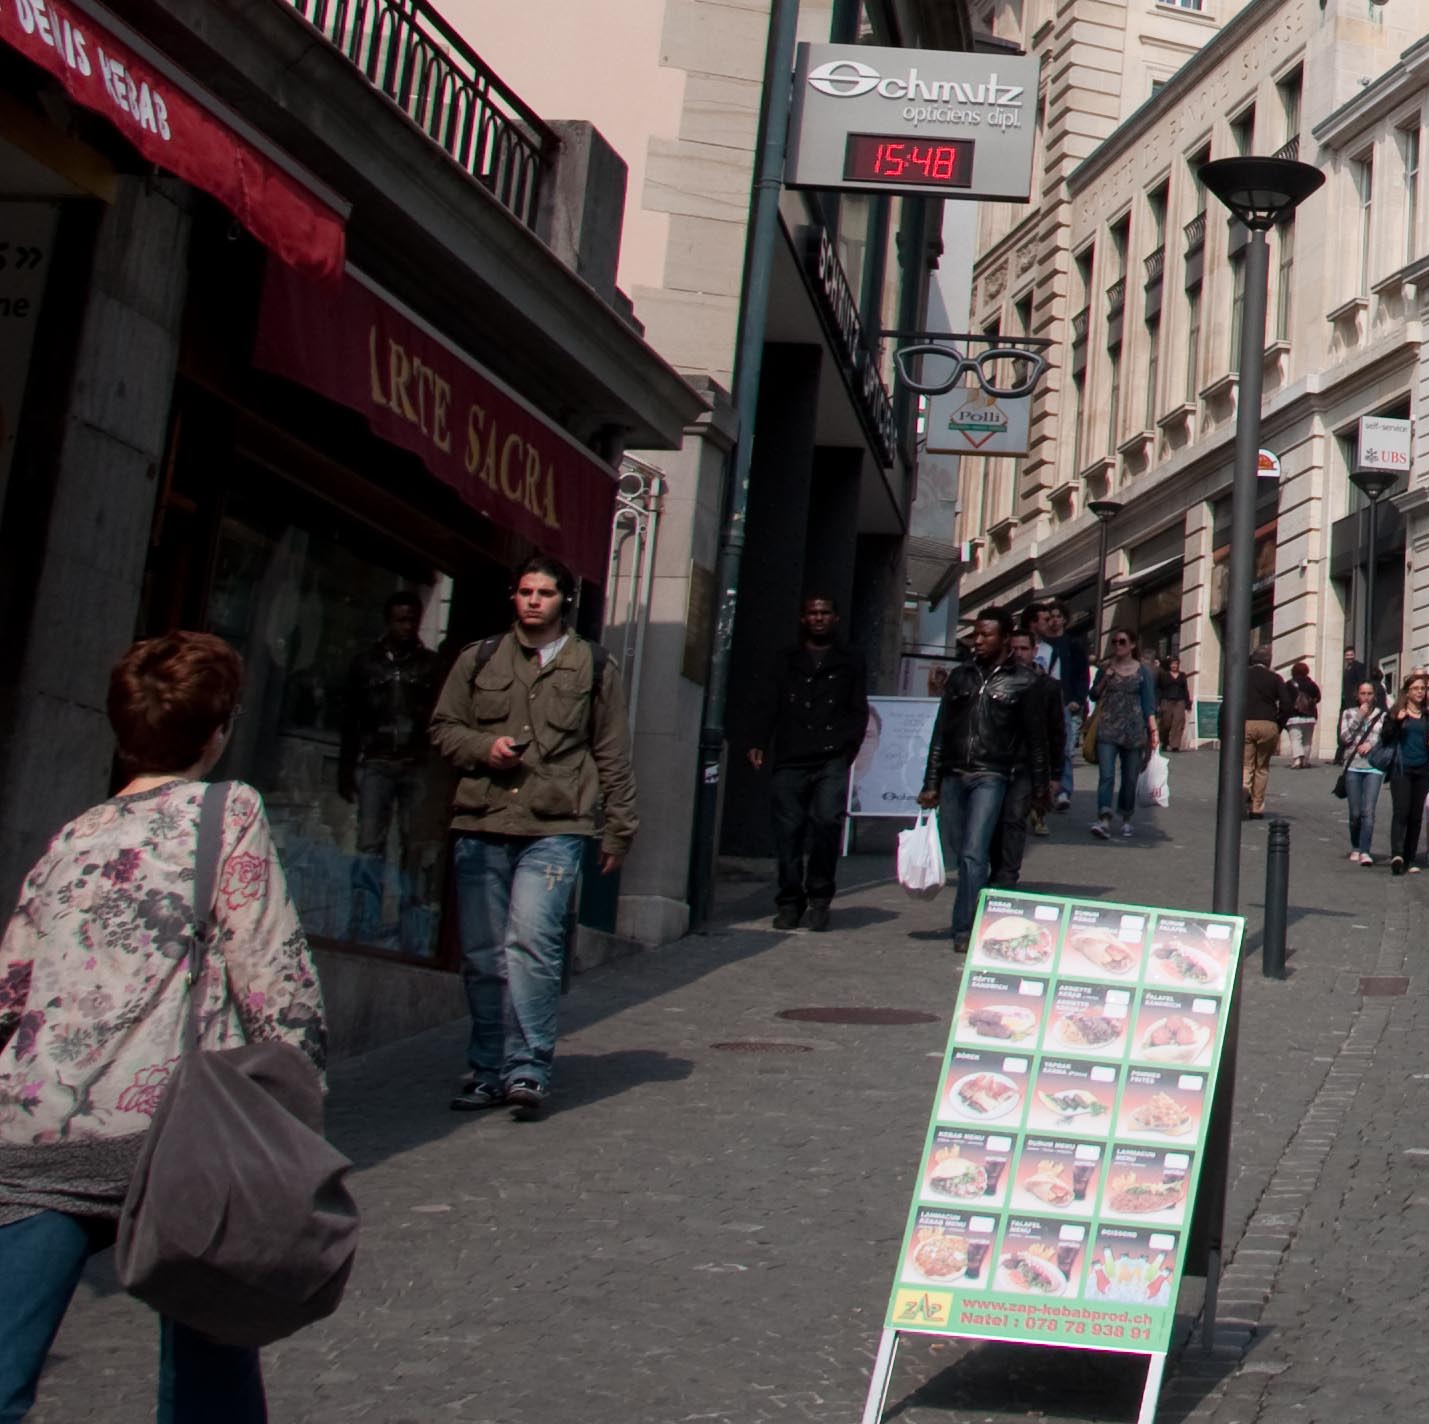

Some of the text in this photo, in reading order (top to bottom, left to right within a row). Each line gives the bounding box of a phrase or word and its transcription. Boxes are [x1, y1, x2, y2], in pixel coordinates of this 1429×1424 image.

[97, 47, 171, 141] KEBAB
[807, 59, 1024, 107] Schmutz
[903, 104, 1022, 132] opticiens dipl.
[873, 143, 957, 180] 15:48
[959, 410, 1000, 423] Polli
[464, 403, 562, 531] SACRA
[1380, 450, 1407, 464] UBS
[903, 1292, 944, 1322] ZAP
[960, 1311, 1008, 1328] Natel
[1064, 1320, 1085, 1335] 78
